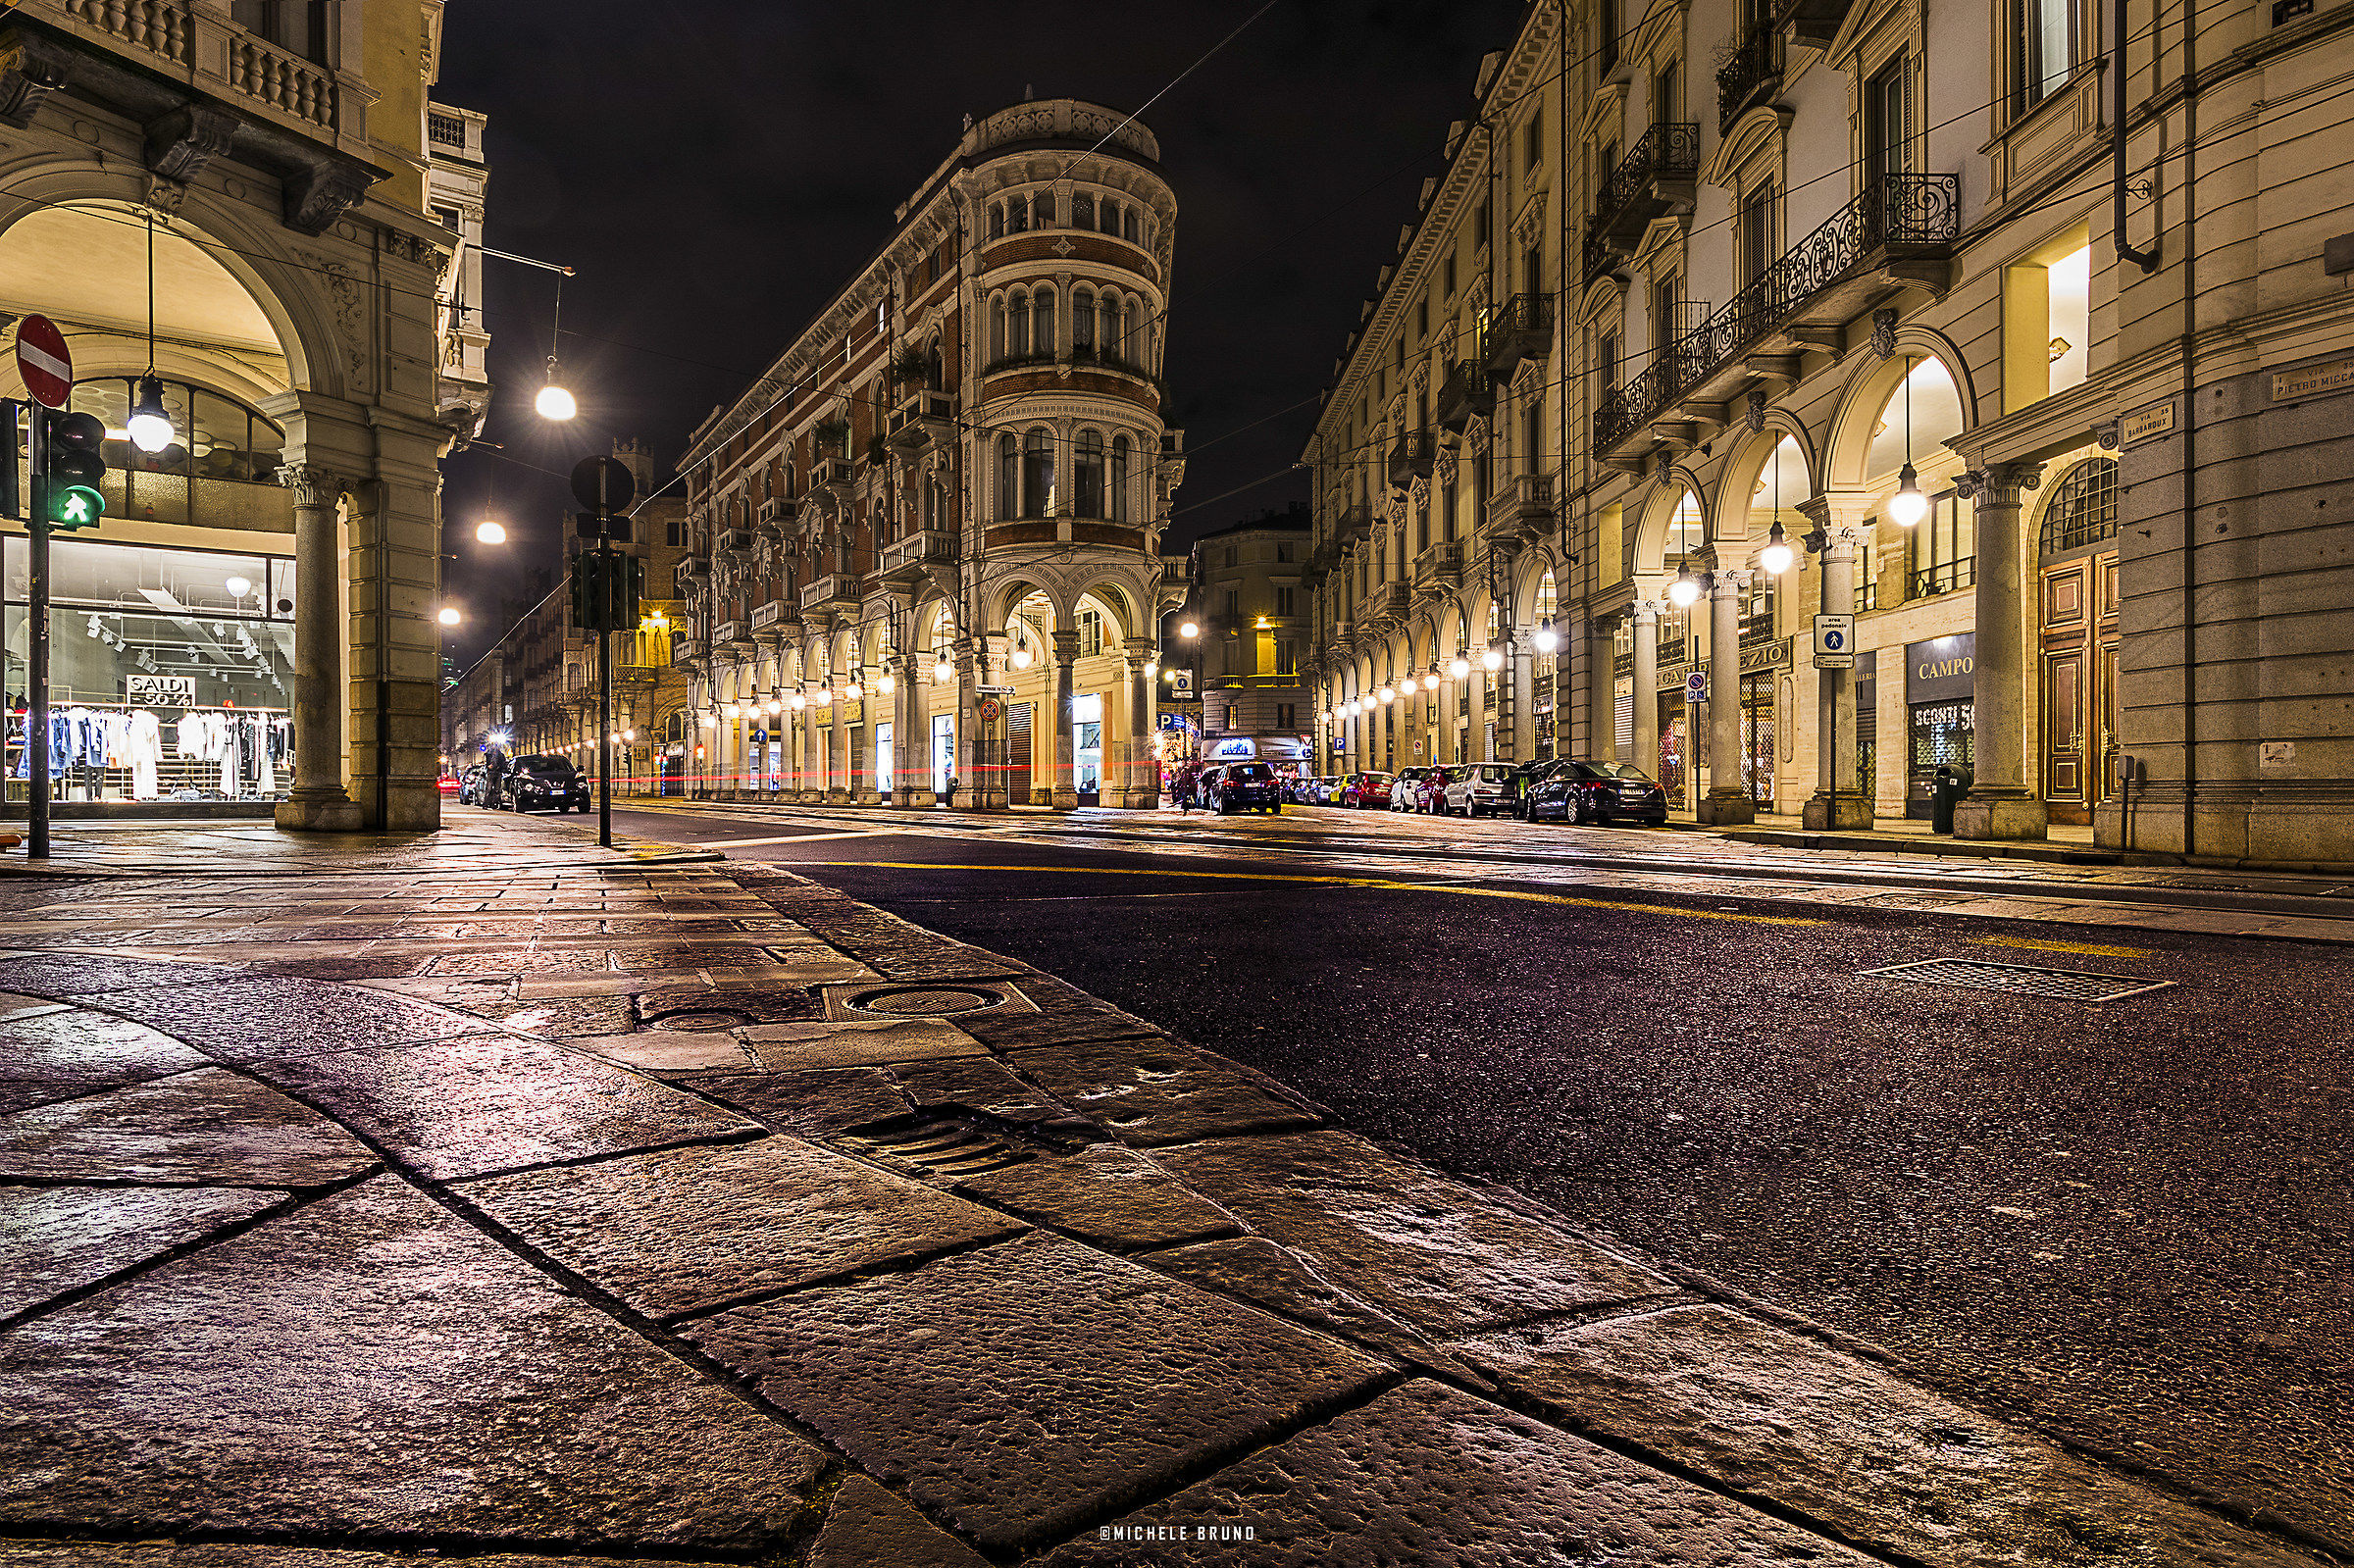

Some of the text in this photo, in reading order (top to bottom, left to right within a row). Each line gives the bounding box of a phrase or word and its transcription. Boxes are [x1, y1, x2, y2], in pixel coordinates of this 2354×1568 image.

[2307, 368, 2325, 377] VIA
[2277, 379, 2317, 394] PIETRO
[2128, 418, 2167, 437] BARBAROUX
[1919, 656, 1973, 680] CAMPO
[130, 677, 189, 693] SALDI
[1160, 714, 1172, 730] P
[1916, 705, 1958, 727] SCONTI
[1336, 738, 1344, 749] P
